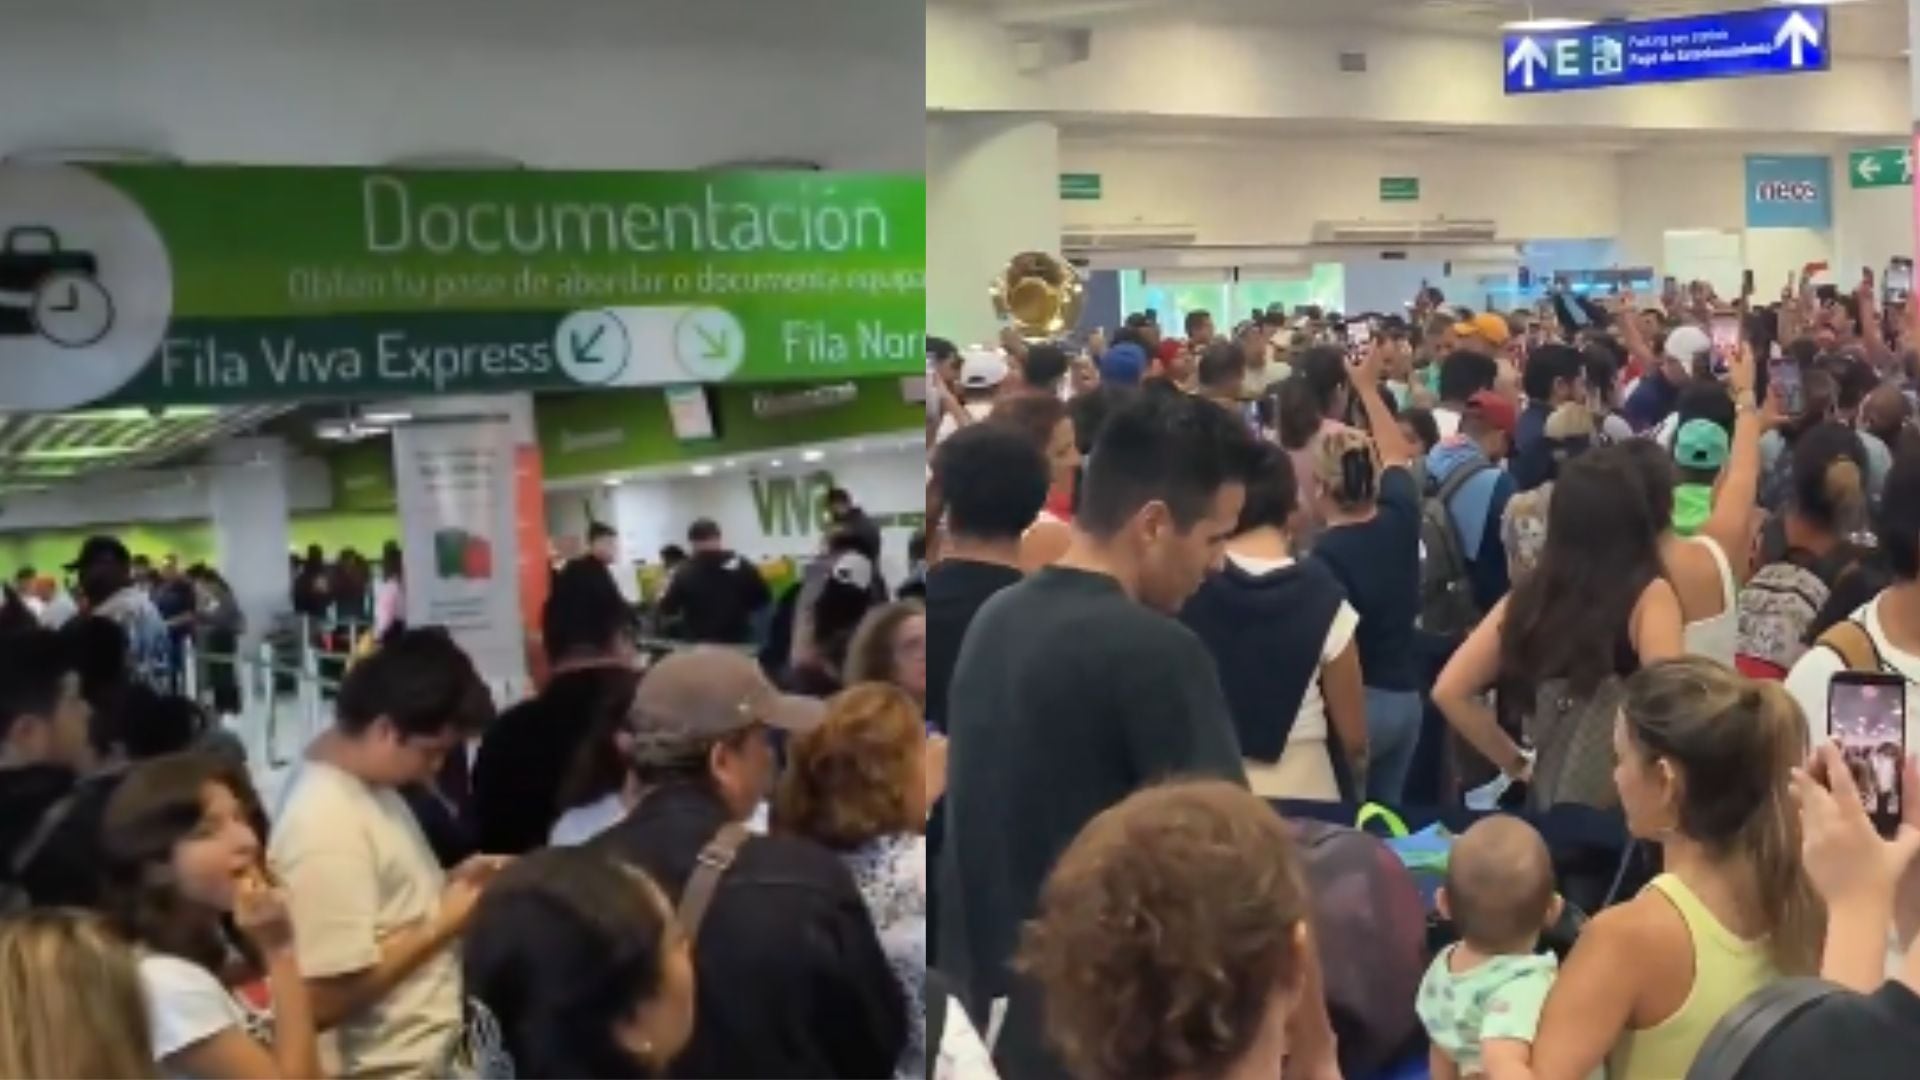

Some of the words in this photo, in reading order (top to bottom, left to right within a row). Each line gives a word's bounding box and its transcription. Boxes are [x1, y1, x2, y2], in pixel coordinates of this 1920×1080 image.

[1556, 39, 1580, 75] E
[363, 174, 889, 254] Documentación
[433, 268, 507, 305] pase
[513, 263, 549, 298] de
[555, 262, 664, 296] abordar
[672, 270, 690, 294] o
[161, 336, 249, 387] Fila
[261, 336, 361, 383] Viva
[376, 333, 552, 390] Express
[782, 319, 848, 364] Fila
